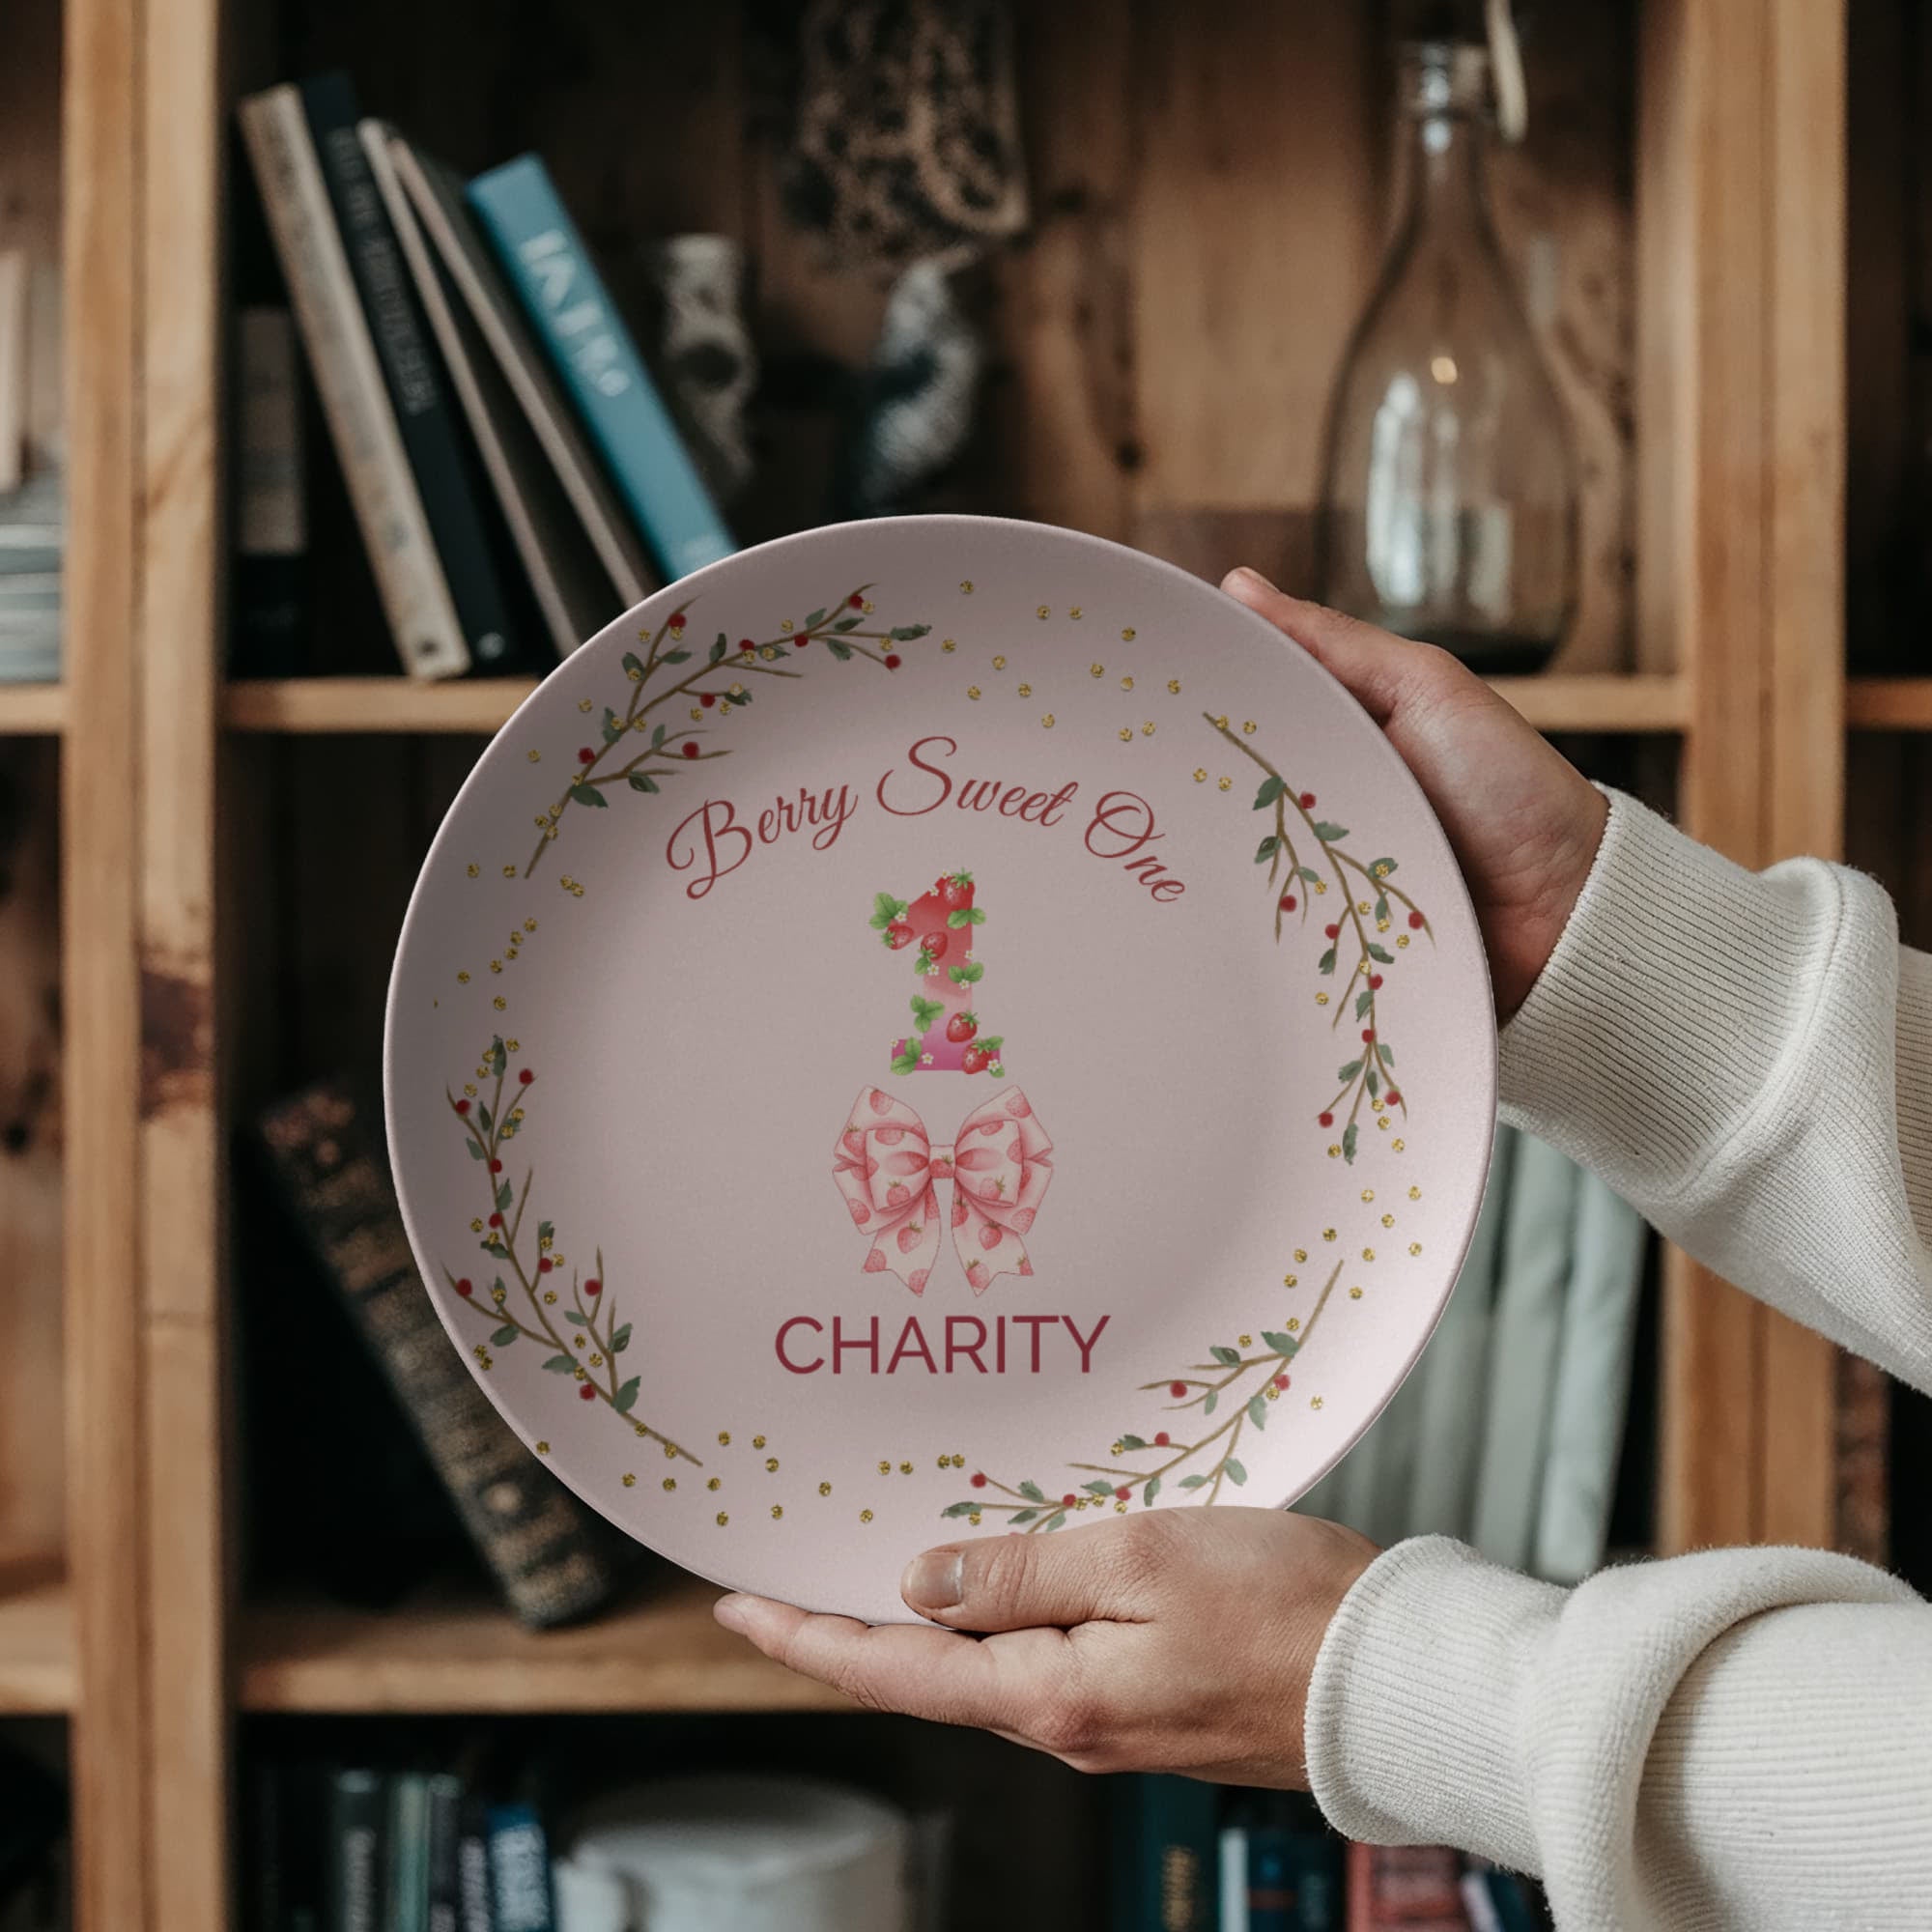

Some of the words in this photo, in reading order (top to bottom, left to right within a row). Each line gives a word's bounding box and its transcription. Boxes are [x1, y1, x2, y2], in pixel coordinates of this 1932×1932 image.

[667, 783, 858, 900] Berry
[876, 736, 1079, 828] Sweet
[1085, 791, 1185, 904] One
[874, 872, 1003, 1075] 1
[775, 1315, 1111, 1376] CHARITY
